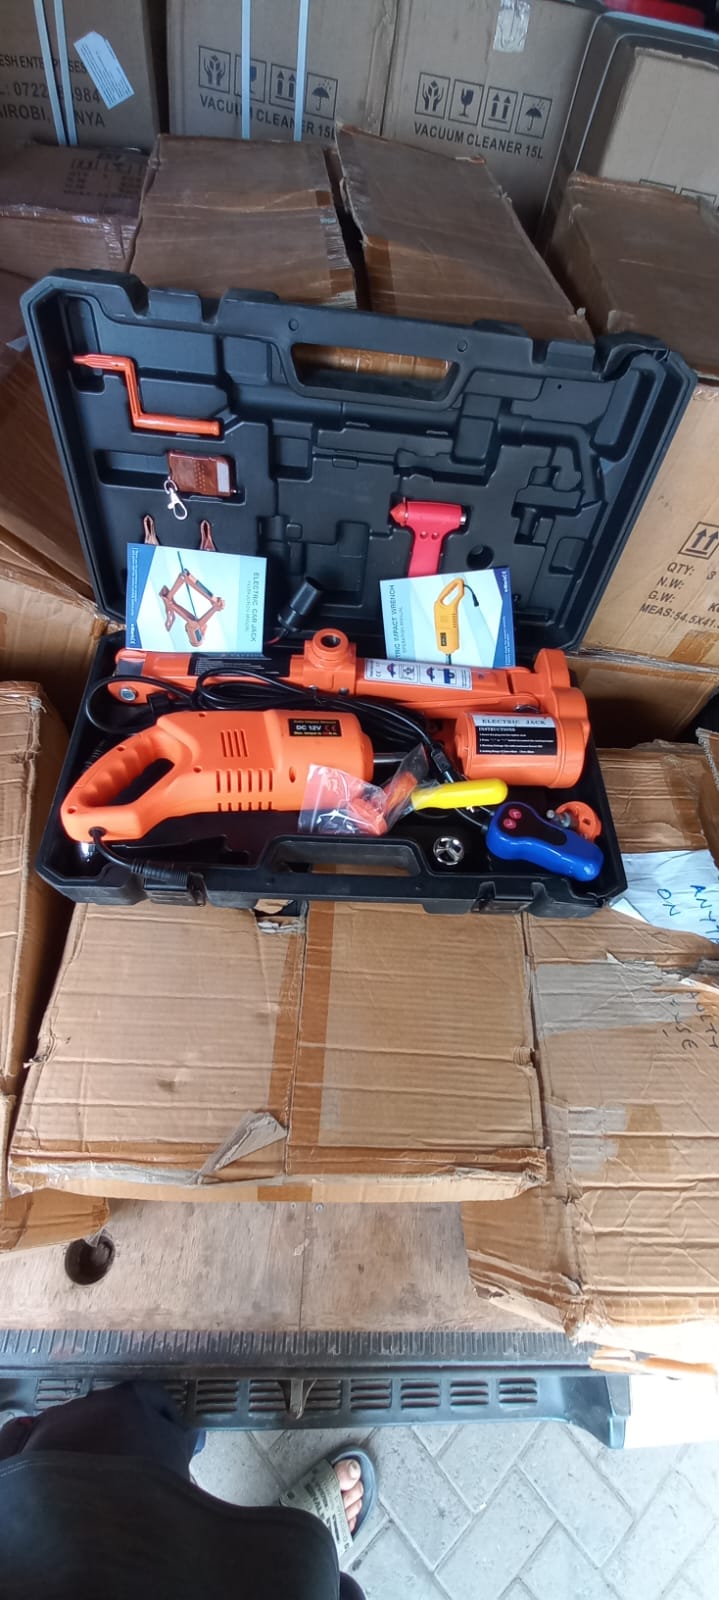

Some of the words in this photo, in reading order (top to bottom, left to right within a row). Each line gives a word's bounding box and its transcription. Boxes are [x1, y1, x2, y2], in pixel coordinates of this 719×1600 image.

[200, 93, 253, 120] VACUU
[414, 122, 464, 143] VACUUM
[466, 133, 522, 154] CLEANER
[526, 144, 543, 160] 15L
[666, 561, 695, 576] QTY:
[252, 571, 260, 606] ELECTRIC
[656, 575, 685, 590] N.W:
[389, 584, 398, 616] WRENCH
[648, 590, 676, 603] G.W:
[391, 616, 400, 642] IMPACT
[639, 602, 719, 629] MEAS:54.5X41.
